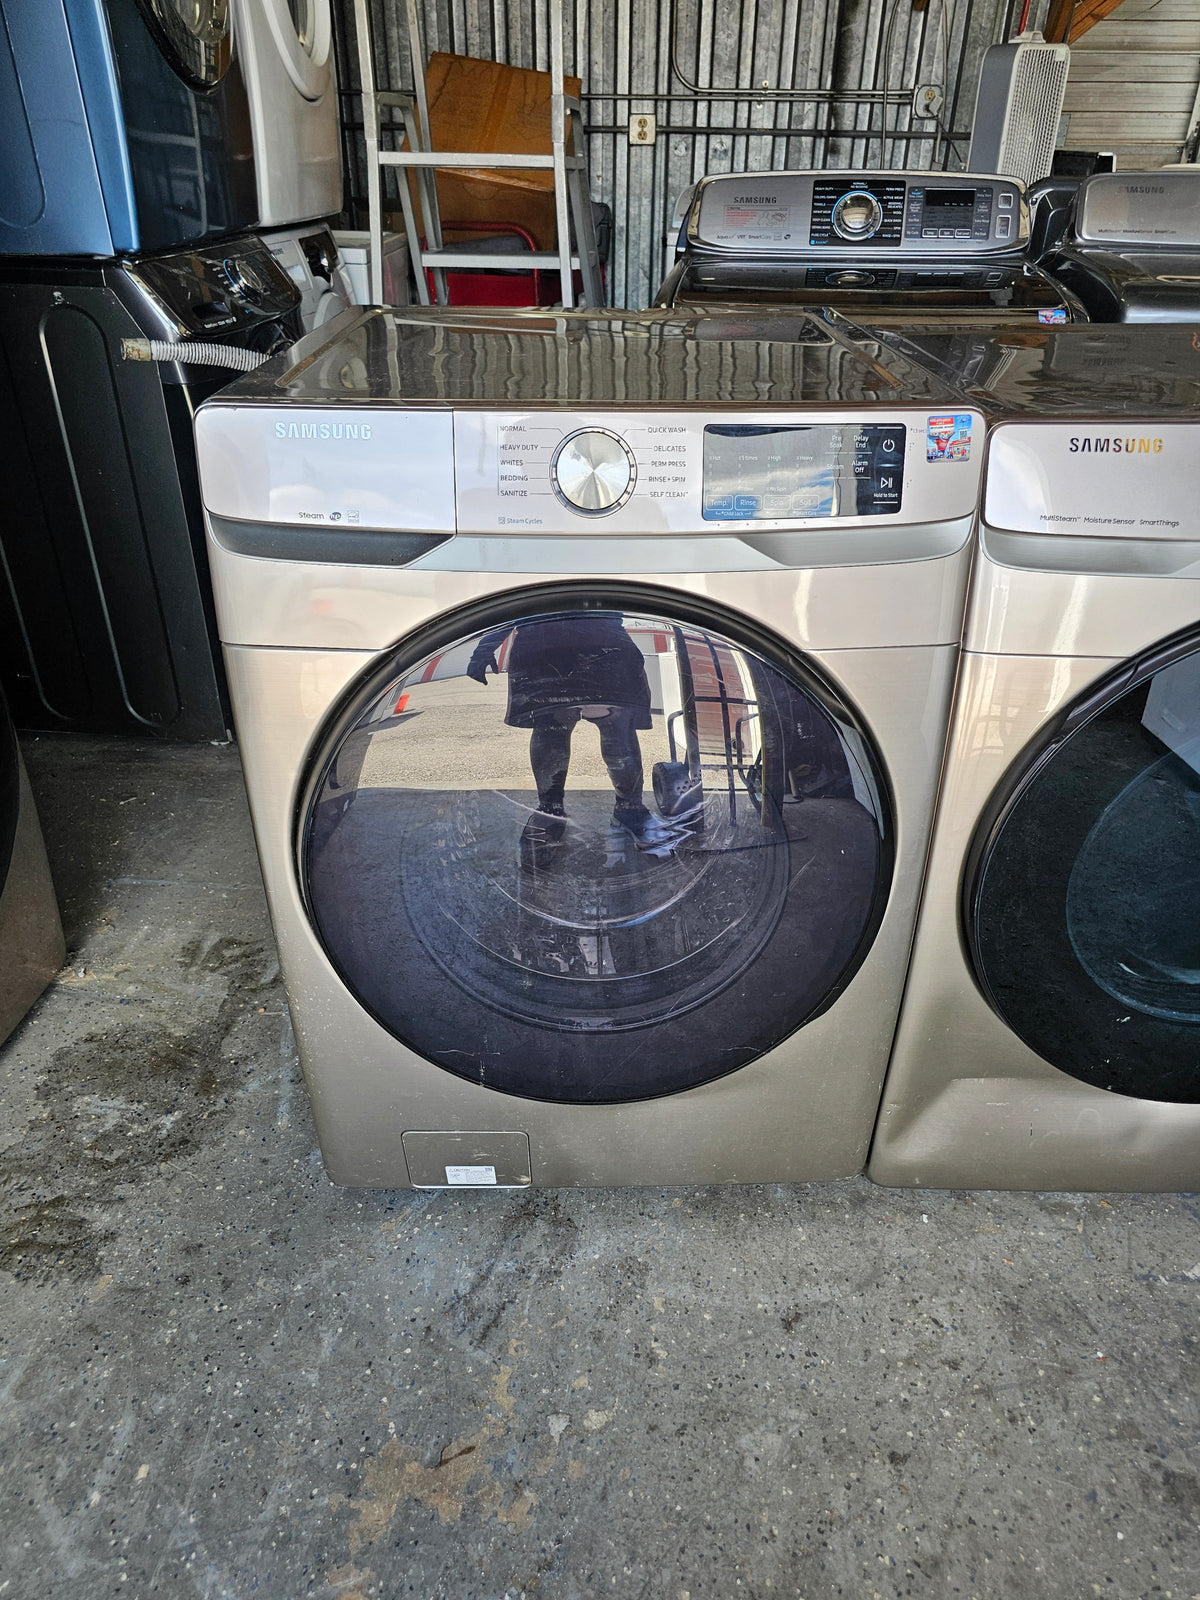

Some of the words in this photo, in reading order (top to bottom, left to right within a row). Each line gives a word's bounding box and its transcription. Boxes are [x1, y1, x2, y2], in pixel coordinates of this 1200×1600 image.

[275, 422, 372, 440] SAMSUNG
[1069, 437, 1164, 454] SAMSUNG
[298, 512, 324, 520] Steam
[1140, 519, 1179, 528] SmartThings
